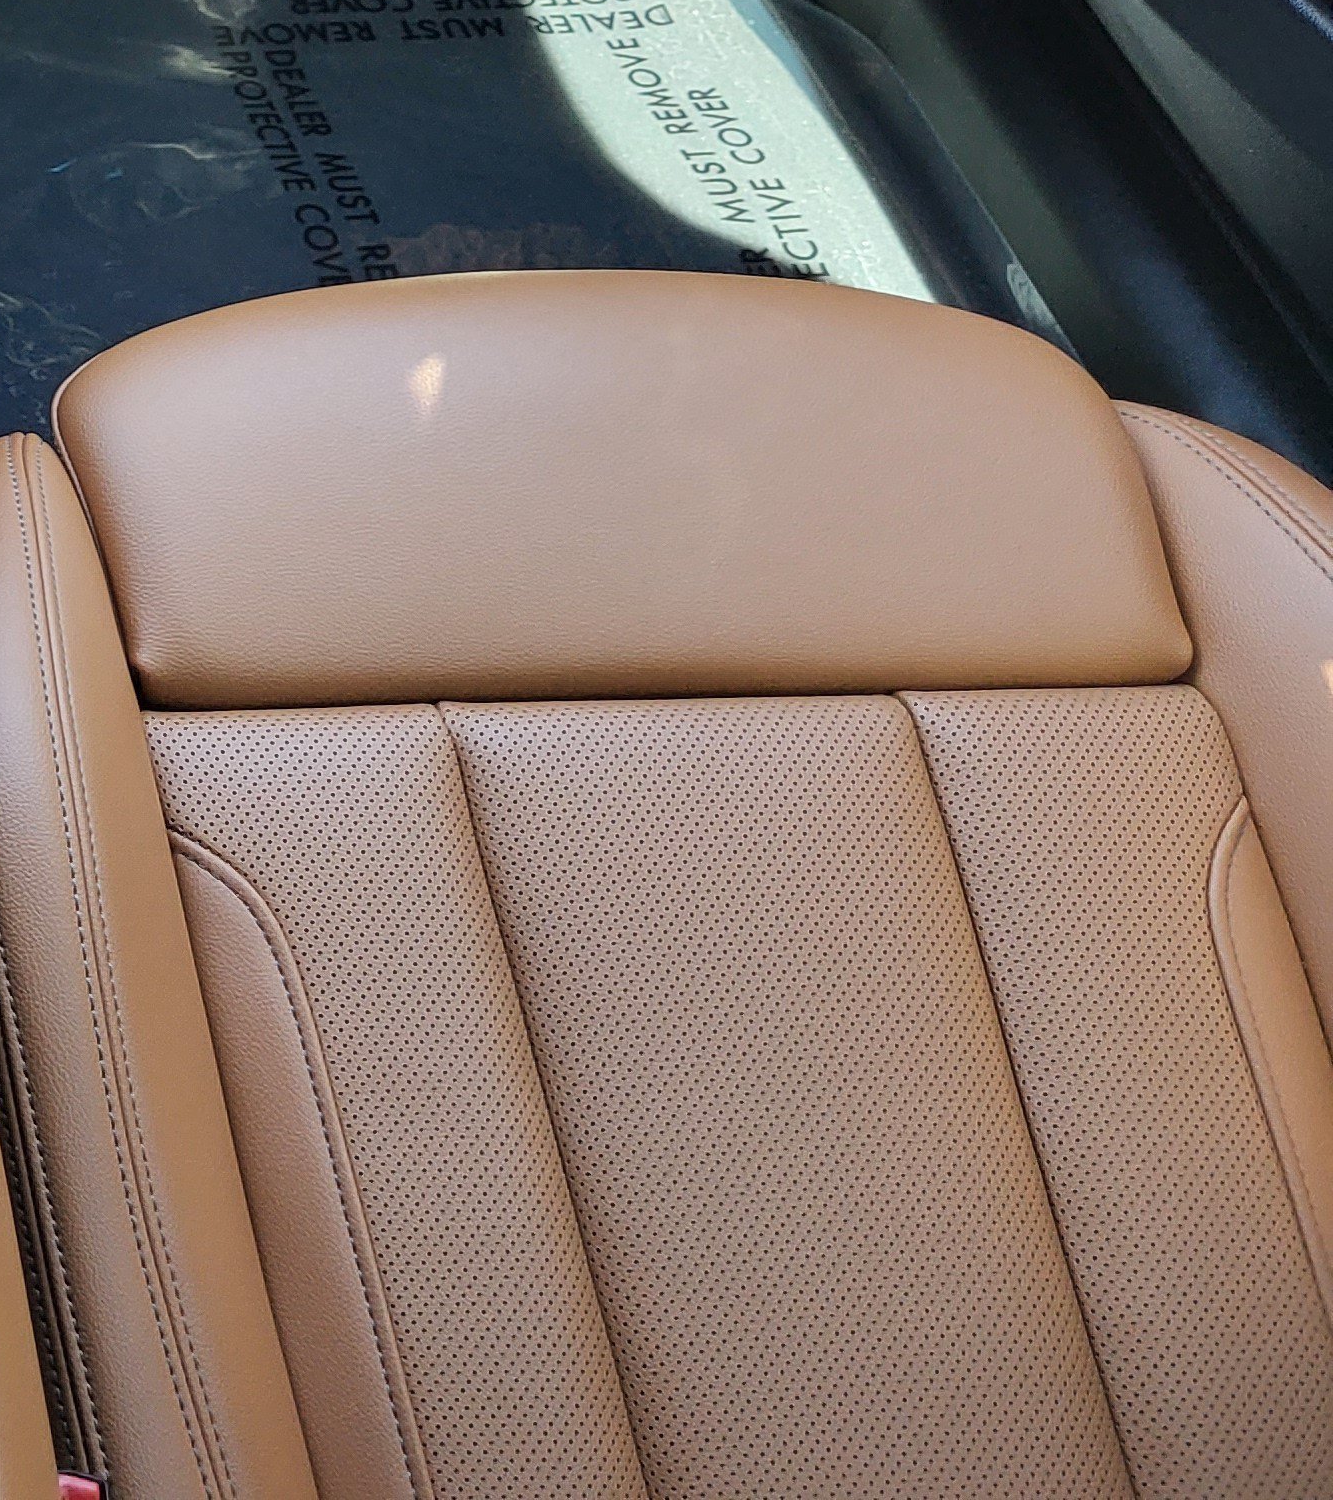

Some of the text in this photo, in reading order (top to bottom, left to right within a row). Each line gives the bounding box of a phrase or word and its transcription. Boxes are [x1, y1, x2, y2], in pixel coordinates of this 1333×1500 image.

[212, 3, 675, 49] DEALER MUST REMOVE
[225, 50, 317, 194] PROTECTIVE
[266, 49, 332, 140] DEALER
[313, 150, 380, 228] MUST
[606, 36, 757, 224] MUST REMOVE
[685, 85, 767, 166] COVER
